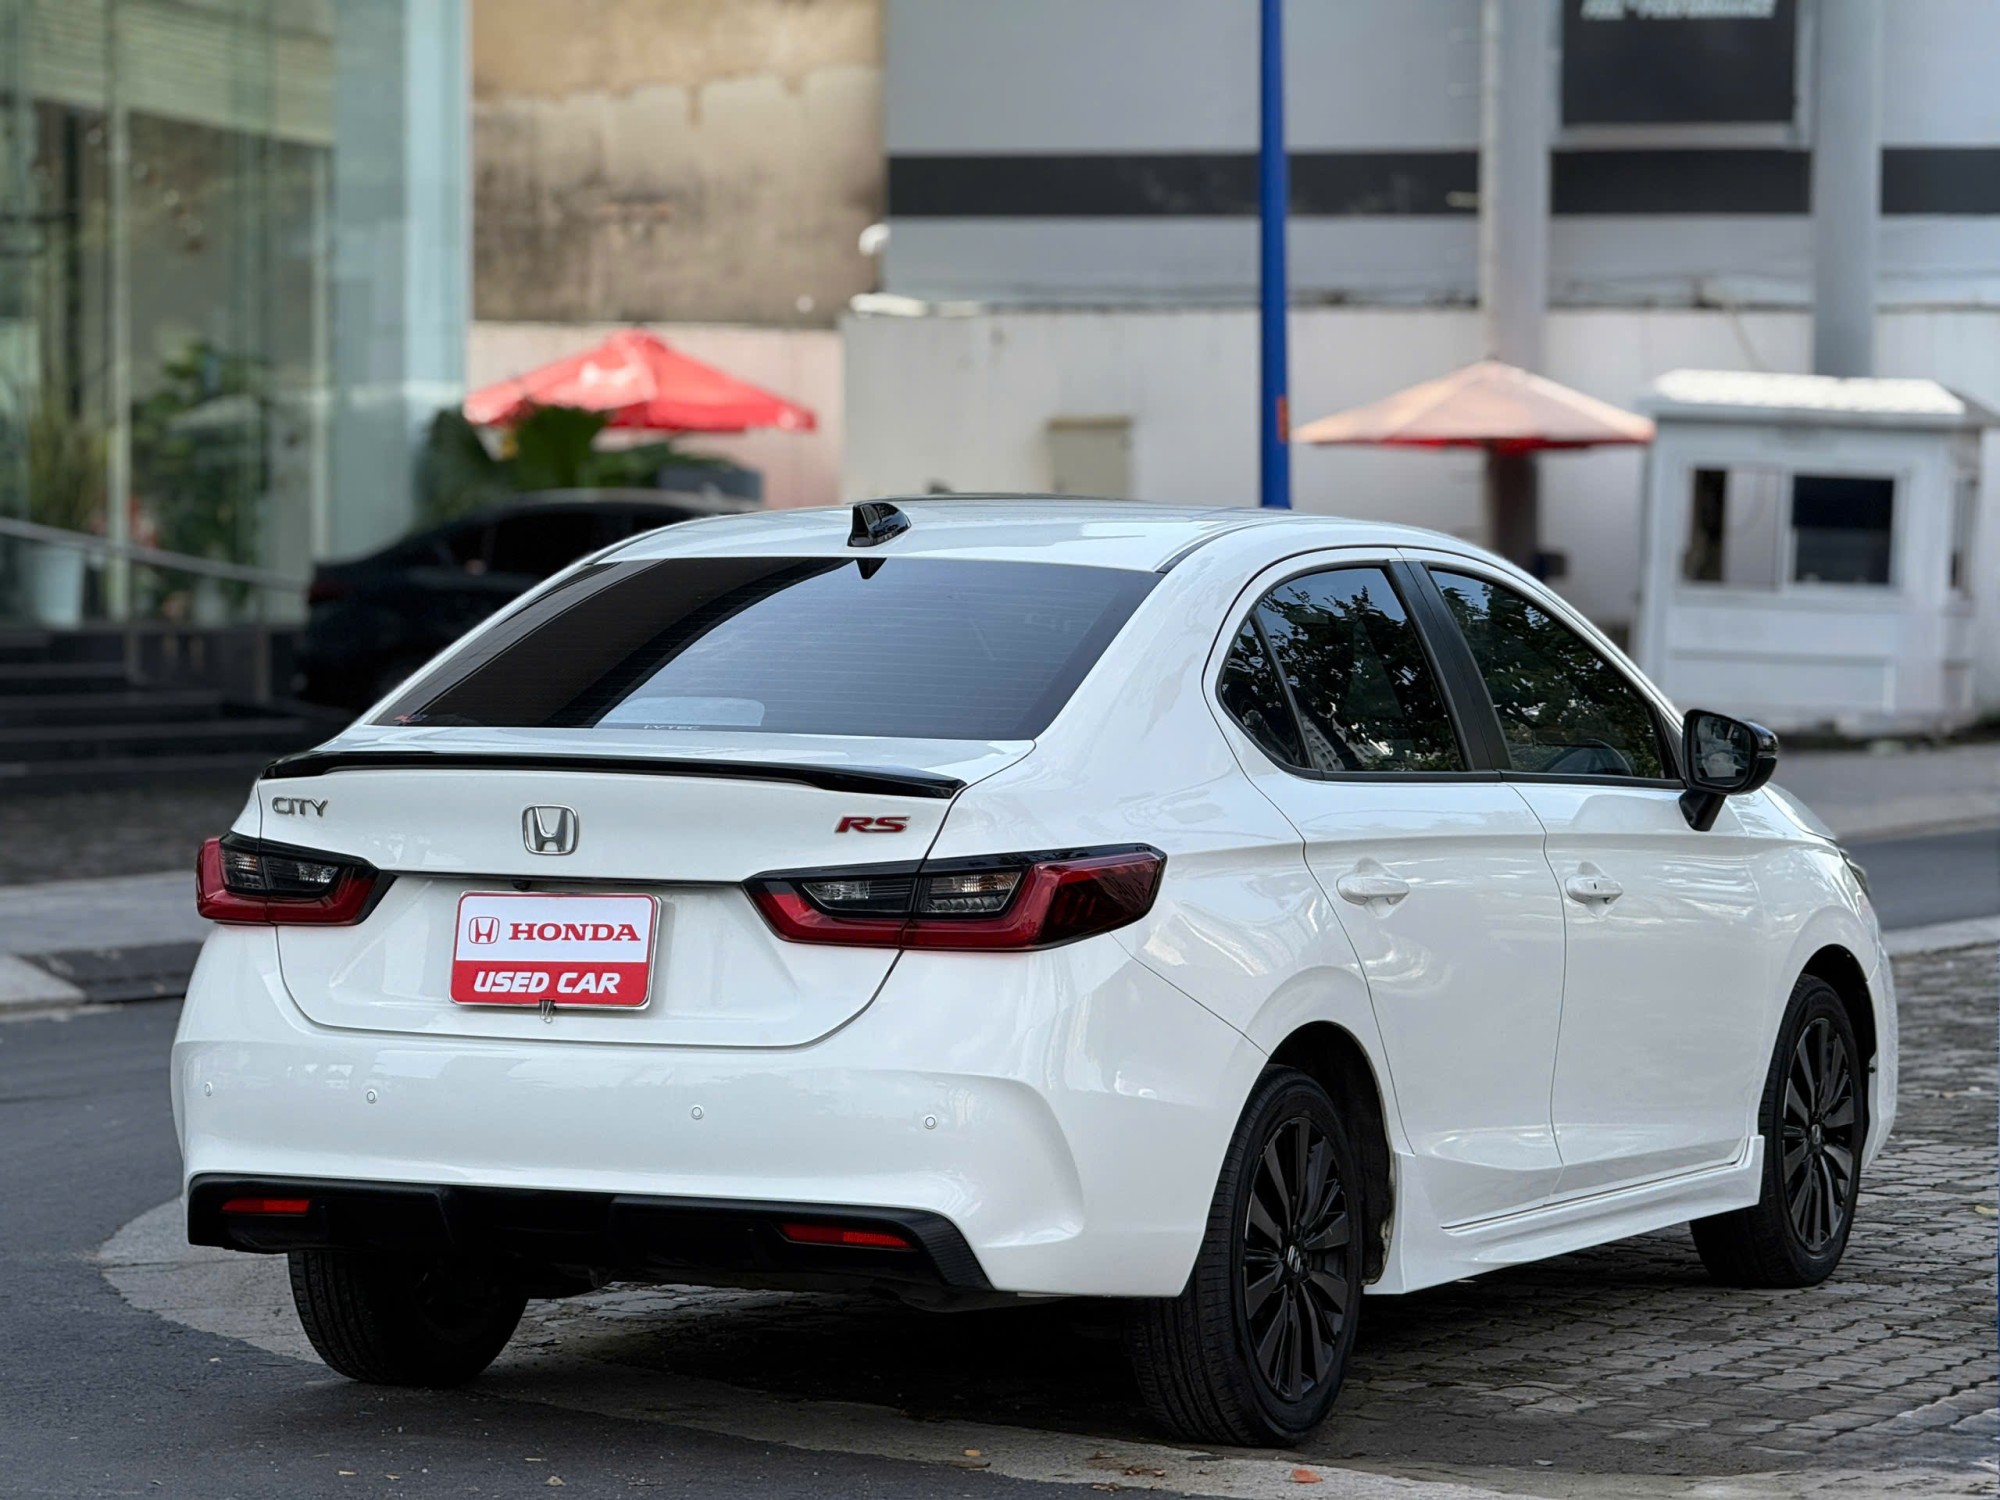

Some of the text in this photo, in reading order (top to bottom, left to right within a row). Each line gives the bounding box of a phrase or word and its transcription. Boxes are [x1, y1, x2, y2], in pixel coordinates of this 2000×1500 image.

[272, 797, 329, 817] CITY
[834, 816, 911, 834] RS
[508, 922, 641, 942] HONDA
[473, 971, 621, 994] USED CAR
